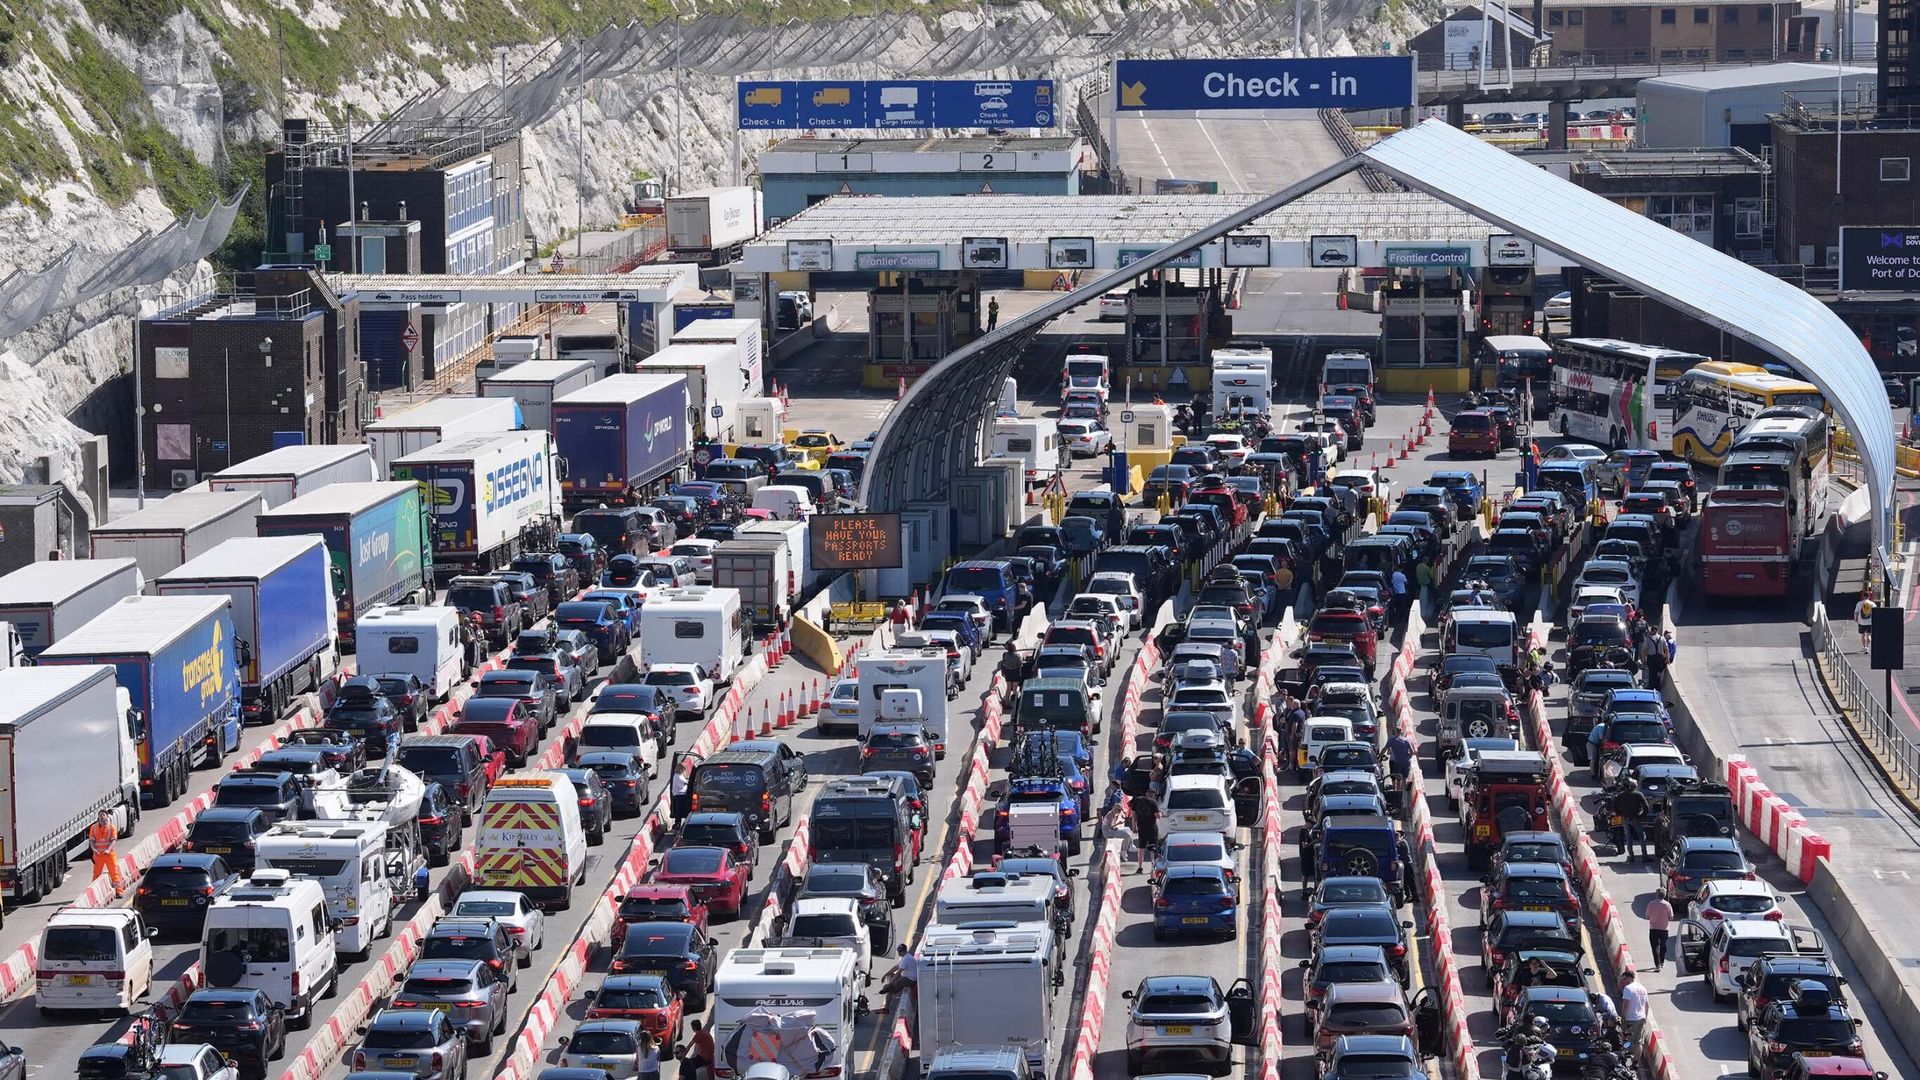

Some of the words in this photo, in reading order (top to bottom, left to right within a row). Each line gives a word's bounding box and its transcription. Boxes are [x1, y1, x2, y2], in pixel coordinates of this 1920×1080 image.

[1203, 71, 1300, 98] Check
[1332, 71, 1358, 96] in
[742, 118, 769, 126] Check
[777, 118, 785, 126] In
[808, 118, 835, 126] Check
[844, 118, 852, 126] In
[841, 155, 848, 169] 1
[983, 155, 994, 169] 2
[860, 256, 898, 265] Frontier
[900, 255, 937, 265] Control
[1390, 253, 1428, 263] Frontier
[1430, 252, 1468, 262] Control
[1867, 255, 1910, 265] Welcome
[1872, 268, 1892, 278] Port
[1895, 268, 1906, 278] of
[418, 292, 443, 300] holders
[486, 452, 543, 514] DISSEGNA
[833, 519, 876, 530] PLEASE
[825, 529, 853, 540] HAVE
[858, 529, 887, 540] YOUR
[358, 538, 371, 568] Jost
[372, 531, 390, 561] Group
[824, 540, 887, 551] PASSPORTS
[838, 550, 873, 561] READY
